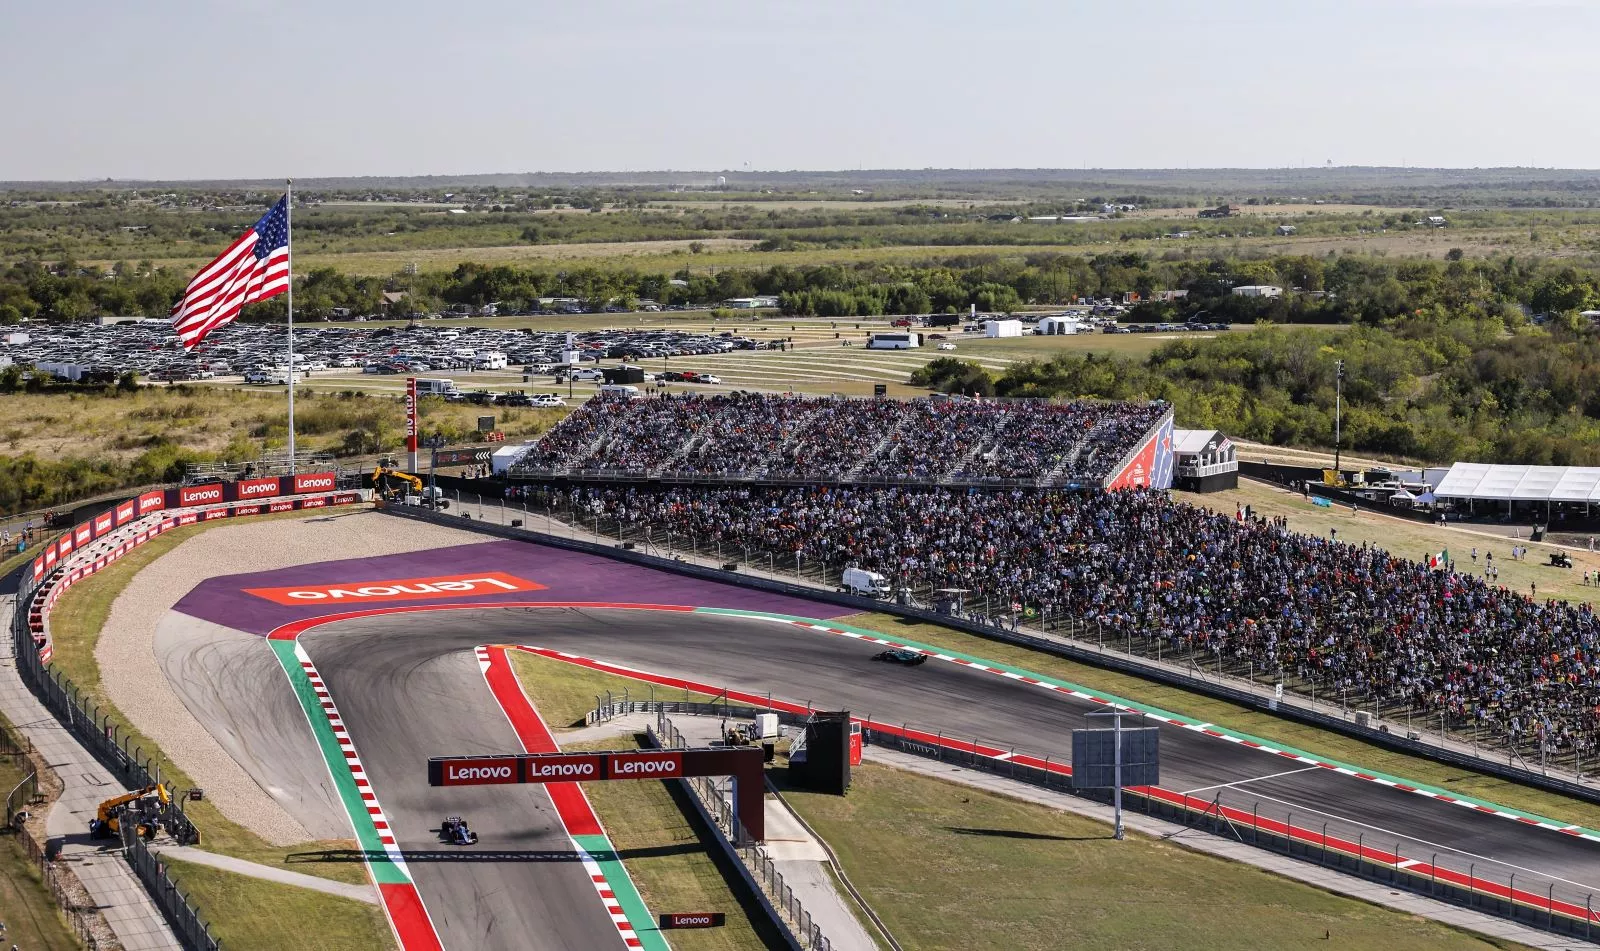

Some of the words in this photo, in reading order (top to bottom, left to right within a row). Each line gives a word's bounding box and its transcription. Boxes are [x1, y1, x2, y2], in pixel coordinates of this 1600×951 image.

[298, 474, 332, 489] Lenovo
[241, 482, 276, 495] Lenovo
[184, 489, 220, 502] Lenovo
[334, 495, 354, 504] Lenovo
[270, 503, 292, 512] Lenovo
[303, 499, 324, 508] Lenovo
[206, 511, 226, 519] Lenovo
[237, 507, 259, 515] Lenovo
[287, 577, 519, 599] Lenovo
[449, 765, 512, 780] Lenovo
[532, 762, 594, 777] Lenovo
[614, 759, 676, 774] Lenovo
[675, 916, 710, 925] Lenovo
